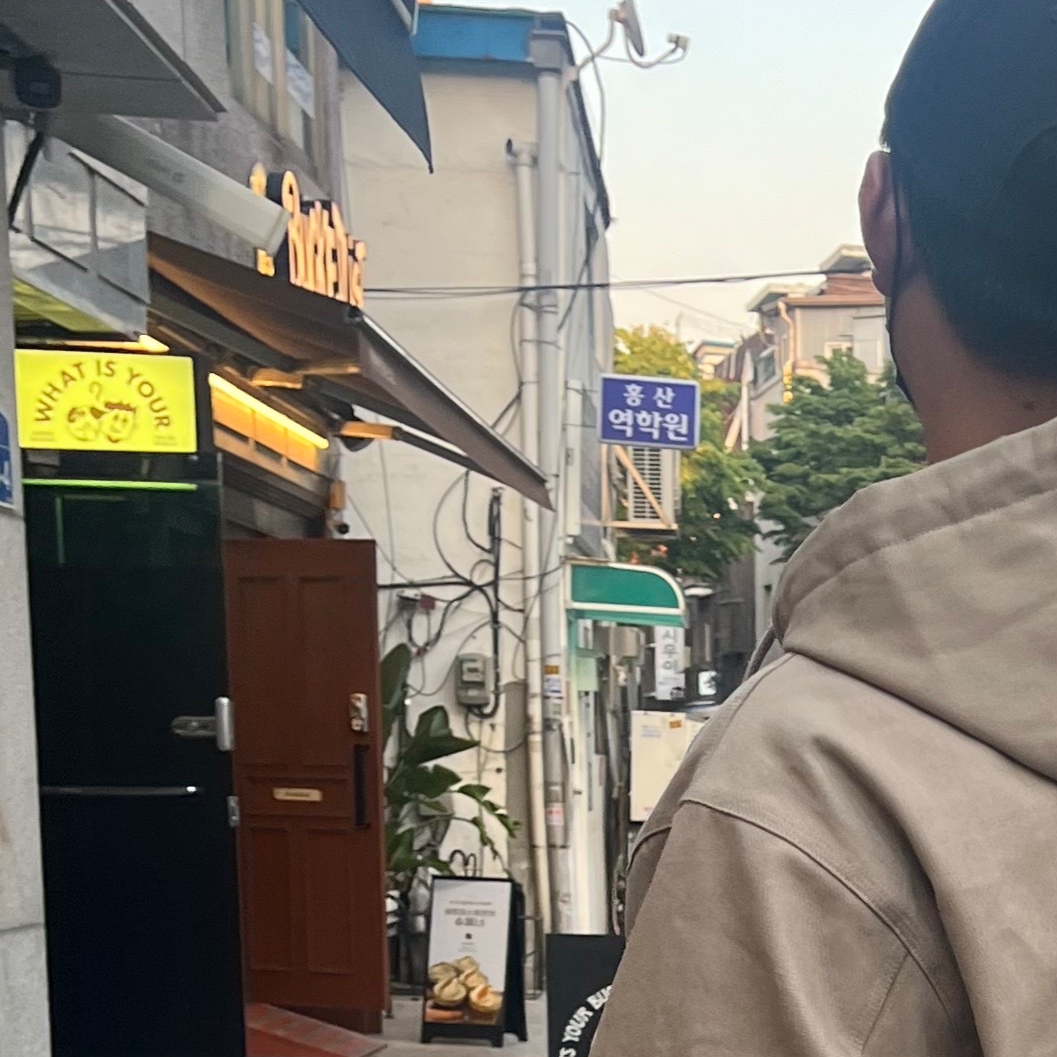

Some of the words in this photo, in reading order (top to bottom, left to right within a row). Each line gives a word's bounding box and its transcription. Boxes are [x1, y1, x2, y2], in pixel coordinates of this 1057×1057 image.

[35, 361, 86, 422] WHAT
[96, 359, 117, 378] IS
[128, 367, 171, 429] YOUR
[608, 408, 689, 442] 역학원
[562, 1006, 594, 1042] YOUR
